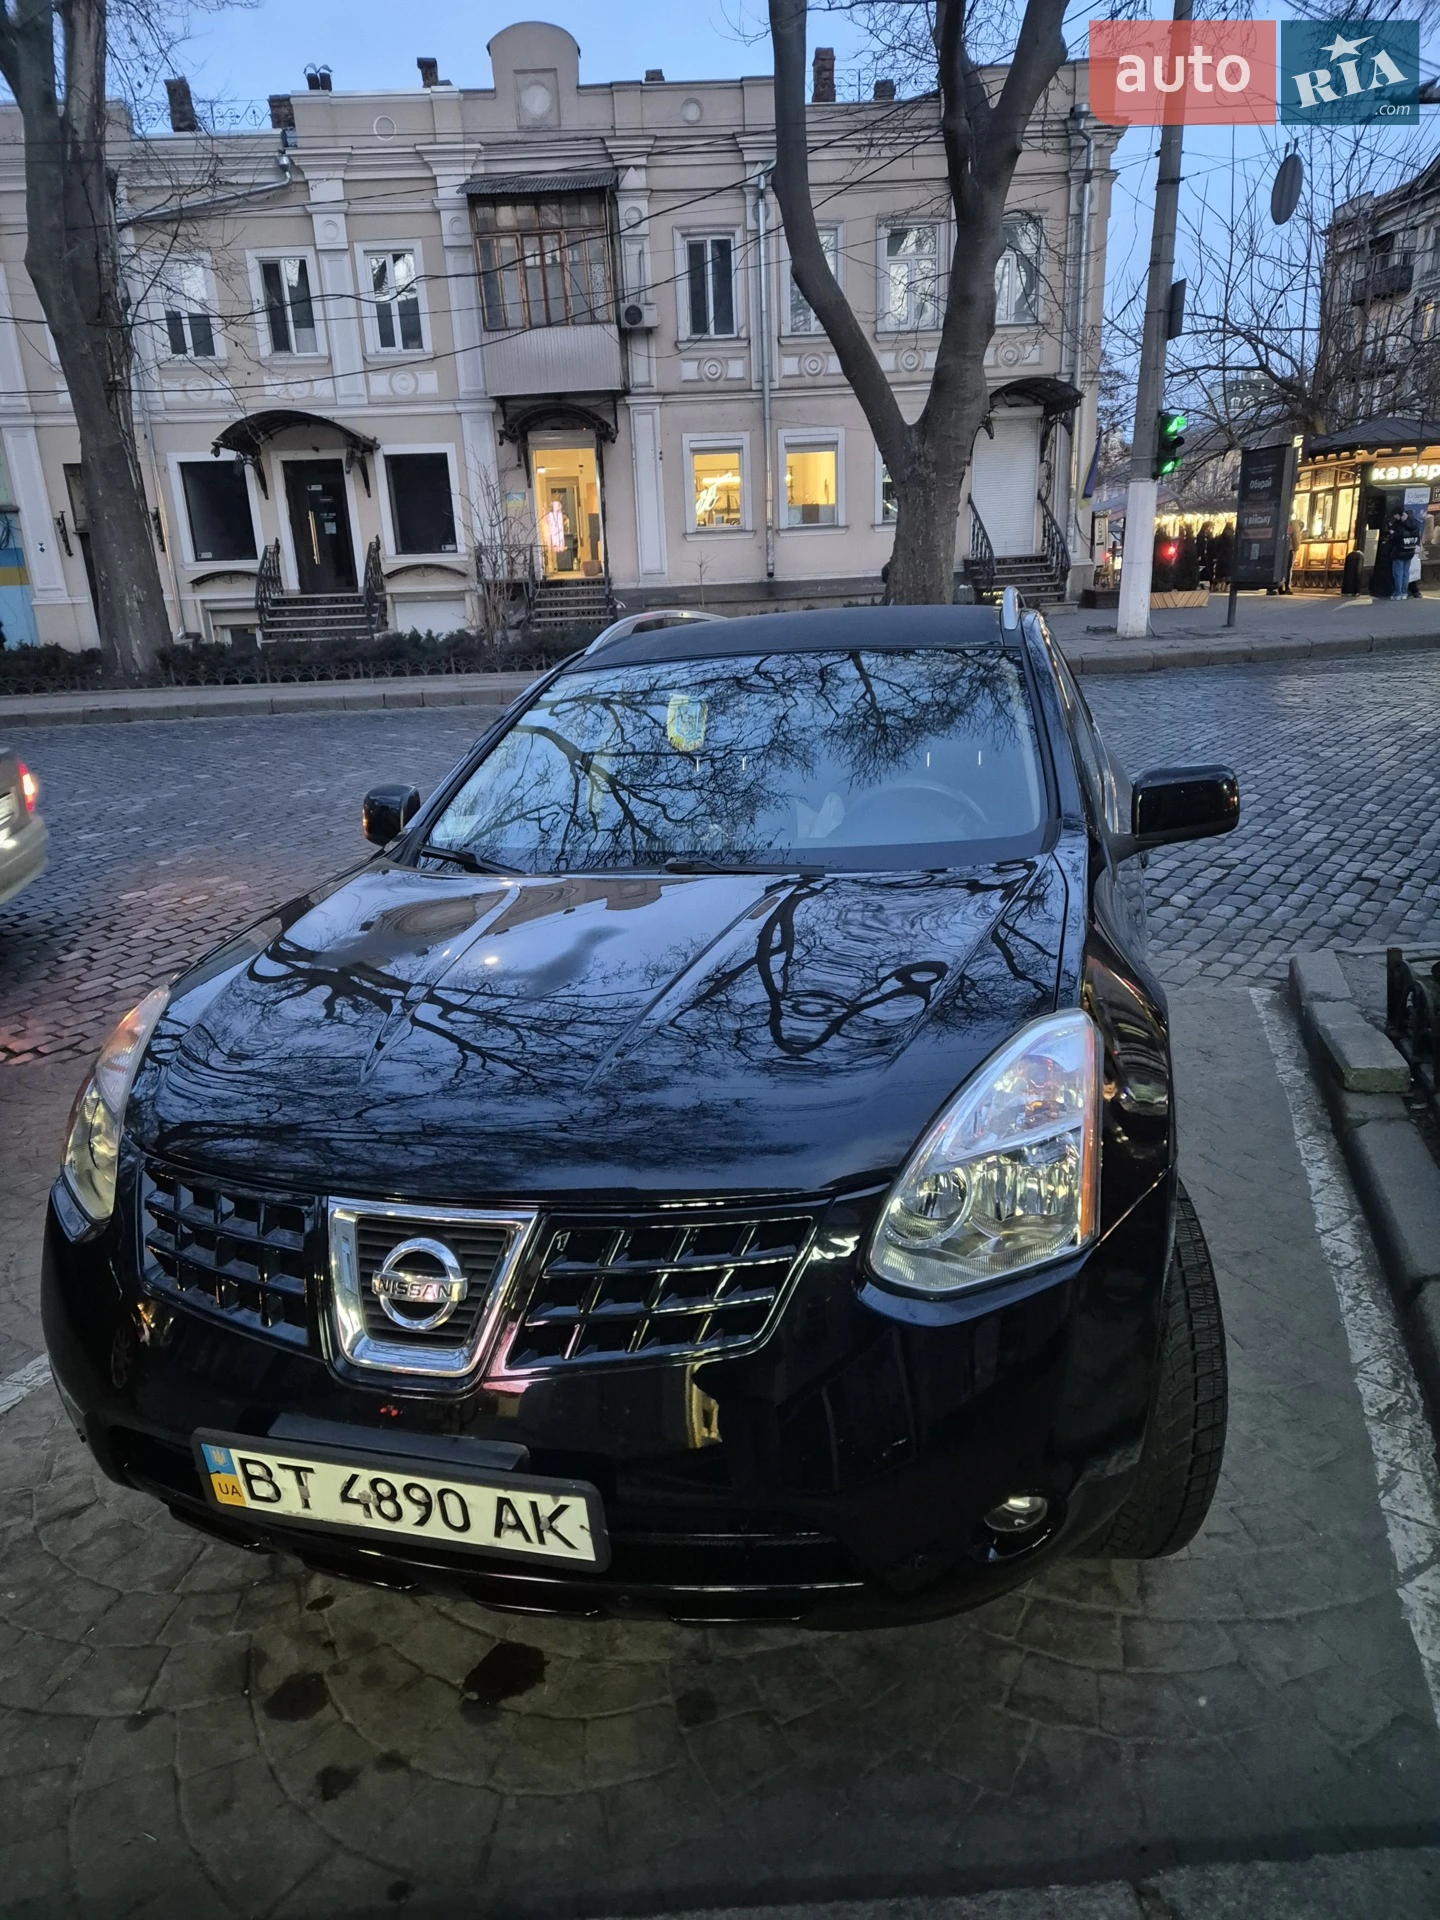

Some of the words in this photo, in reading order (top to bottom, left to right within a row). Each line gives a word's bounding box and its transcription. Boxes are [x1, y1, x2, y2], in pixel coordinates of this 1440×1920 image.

[379, 1278, 453, 1299] NISSAN
[219, 1483, 242, 1498] UA
[238, 1457, 315, 1510] BT
[340, 1473, 472, 1533] 4890
[493, 1496, 580, 1550] AK
